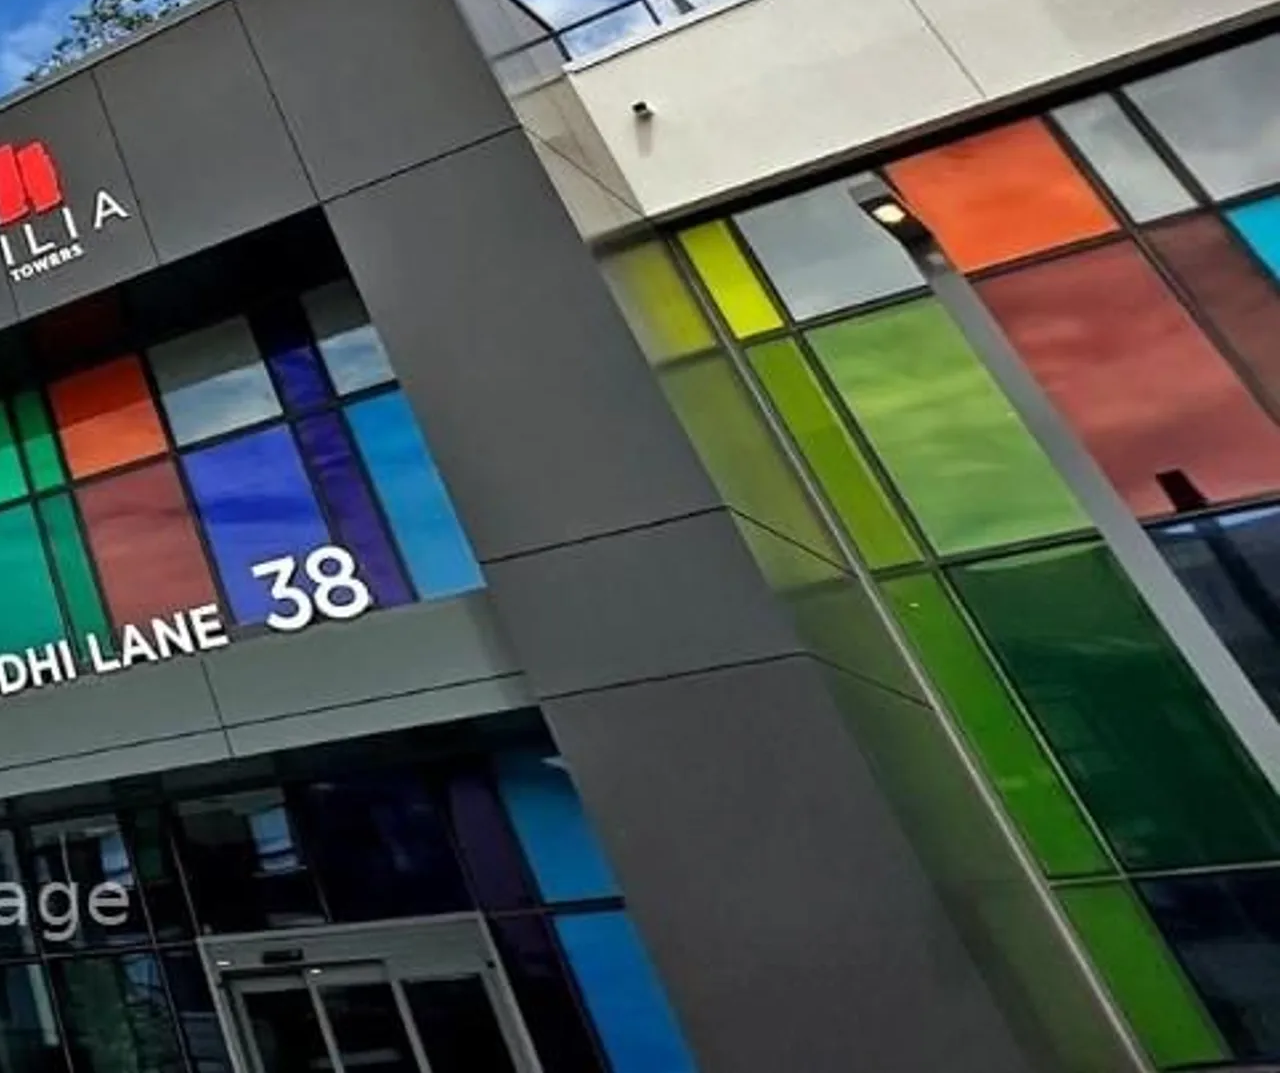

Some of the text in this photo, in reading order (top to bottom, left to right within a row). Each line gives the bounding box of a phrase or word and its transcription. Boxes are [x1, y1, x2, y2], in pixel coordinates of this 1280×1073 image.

[9, 242, 84, 282] TOWERS
[86, 603, 230, 674] LANE
[250, 545, 371, 630] 38
